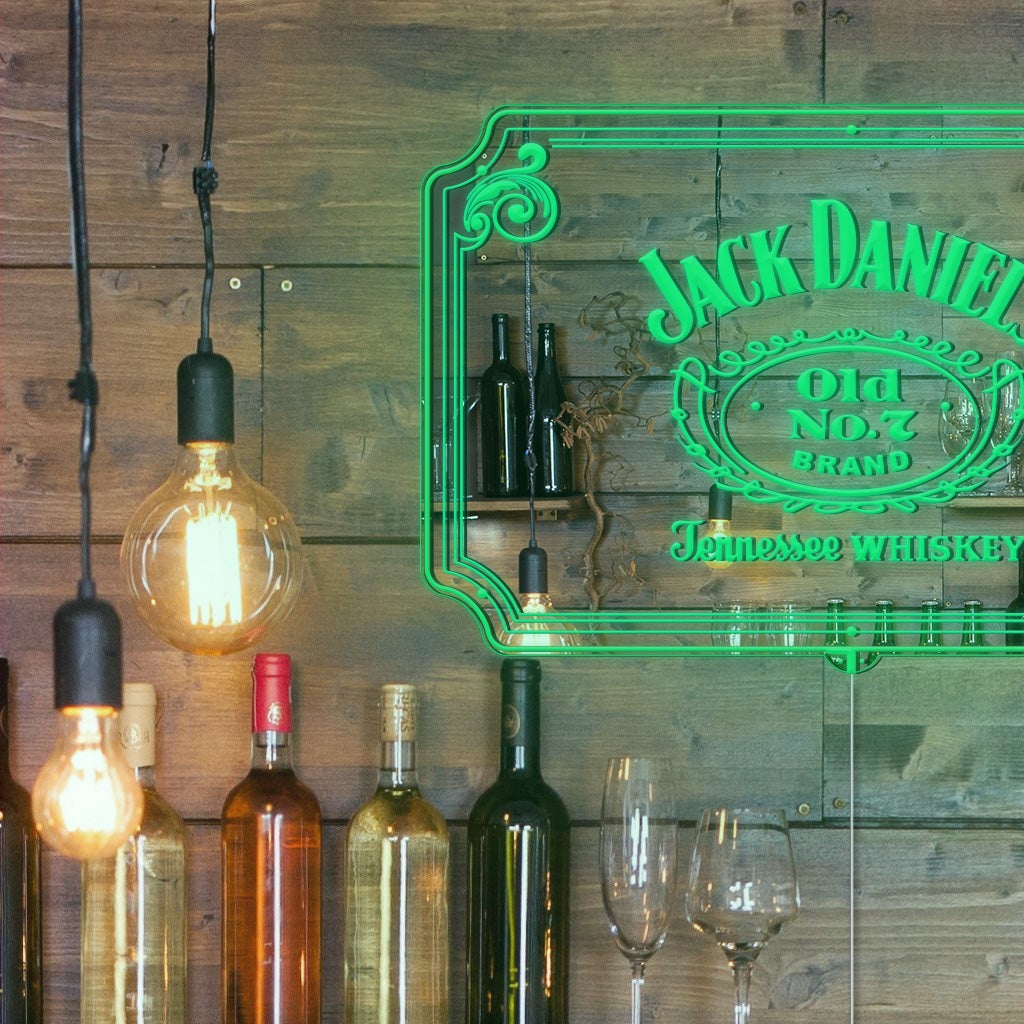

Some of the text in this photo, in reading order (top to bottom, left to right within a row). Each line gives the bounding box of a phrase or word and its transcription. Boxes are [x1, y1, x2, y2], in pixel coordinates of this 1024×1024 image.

[638, 224, 806, 344] JACK
[797, 367, 904, 402] Old
[792, 449, 912, 476] BRAND
[670, 520, 843, 562] Tennessee
